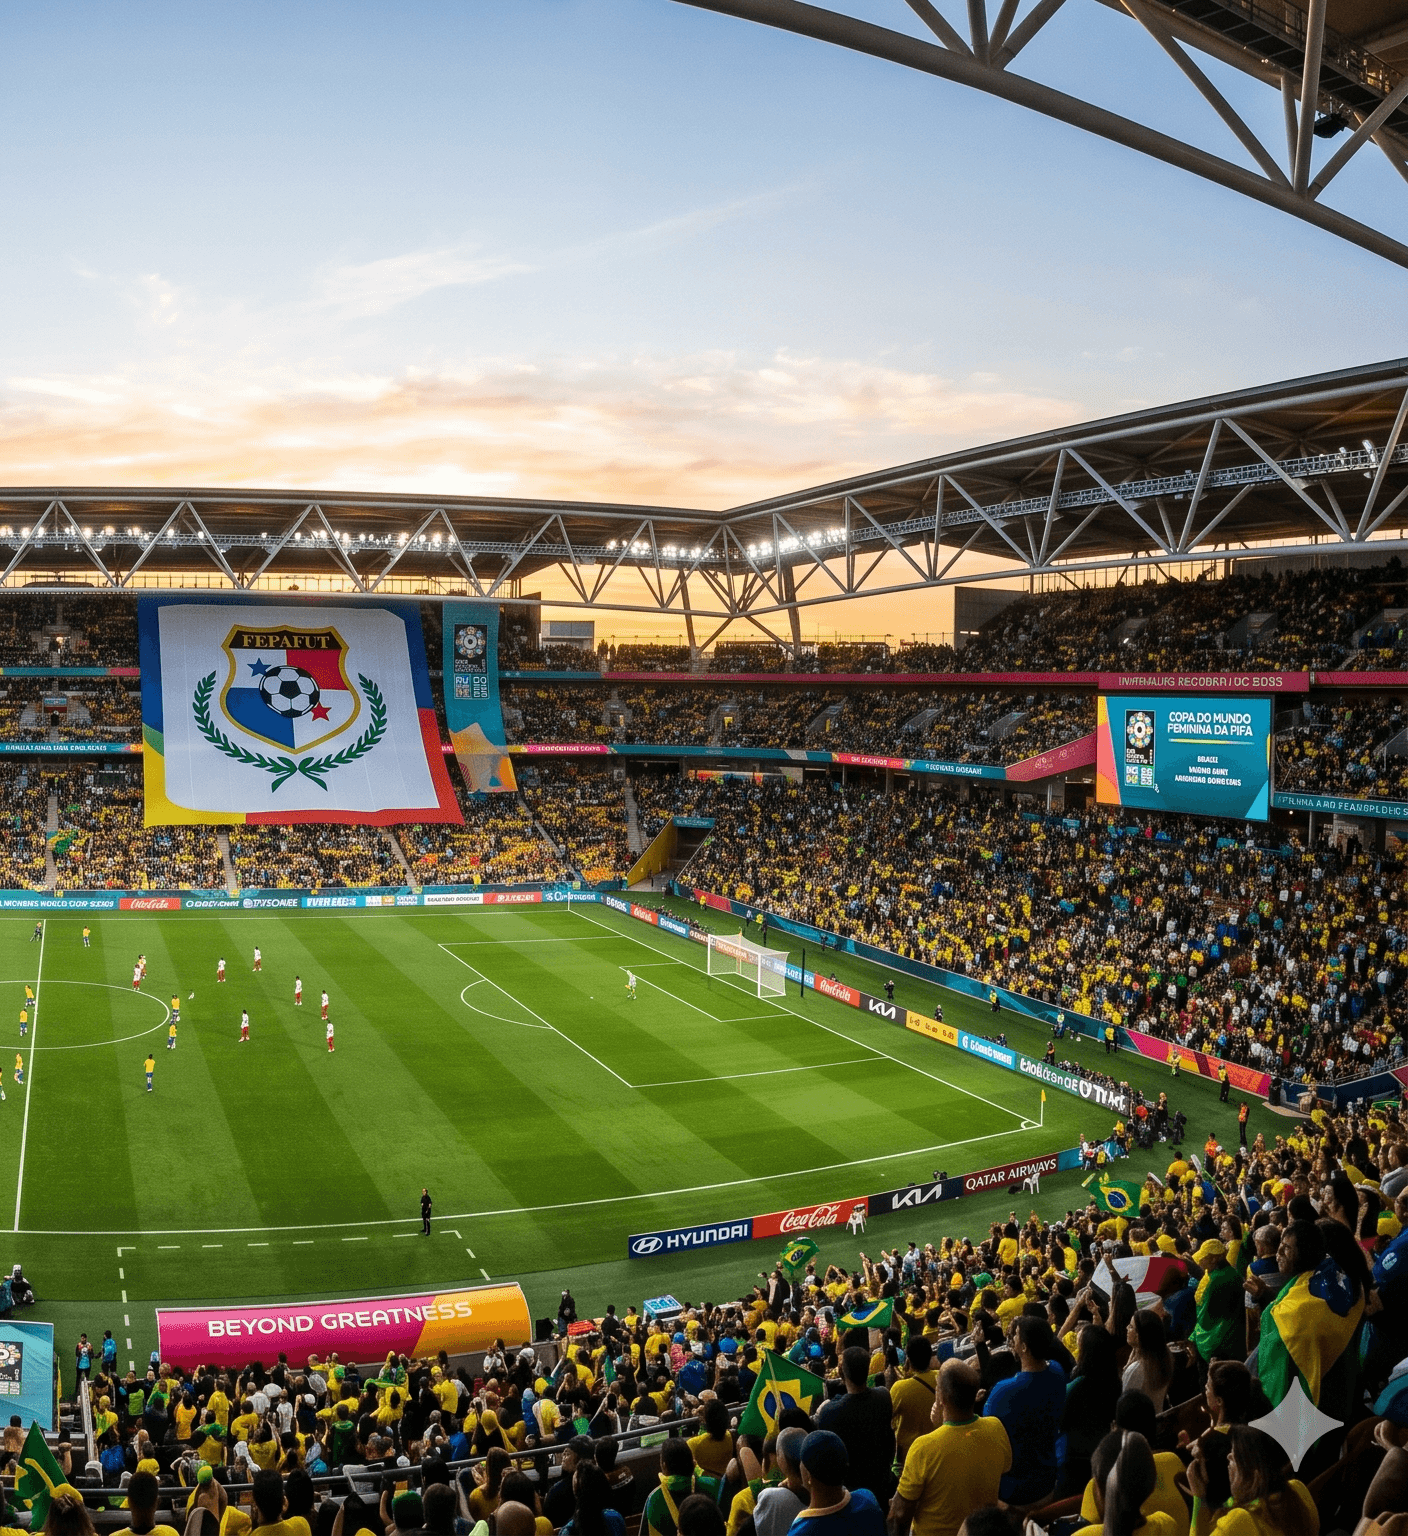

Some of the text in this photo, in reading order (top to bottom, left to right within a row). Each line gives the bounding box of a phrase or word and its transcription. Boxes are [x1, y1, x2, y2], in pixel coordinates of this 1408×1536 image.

[242, 633, 331, 650] FEPAFUT
[1168, 711, 1252, 725] COPA DO MUNDO
[1213, 724, 1229, 736] DA
[965, 1158, 1057, 1191] QATAR AIRWAYS
[666, 1223, 749, 1249] HYUNDAI
[207, 1300, 473, 1338] BEYOND GREATNESS
